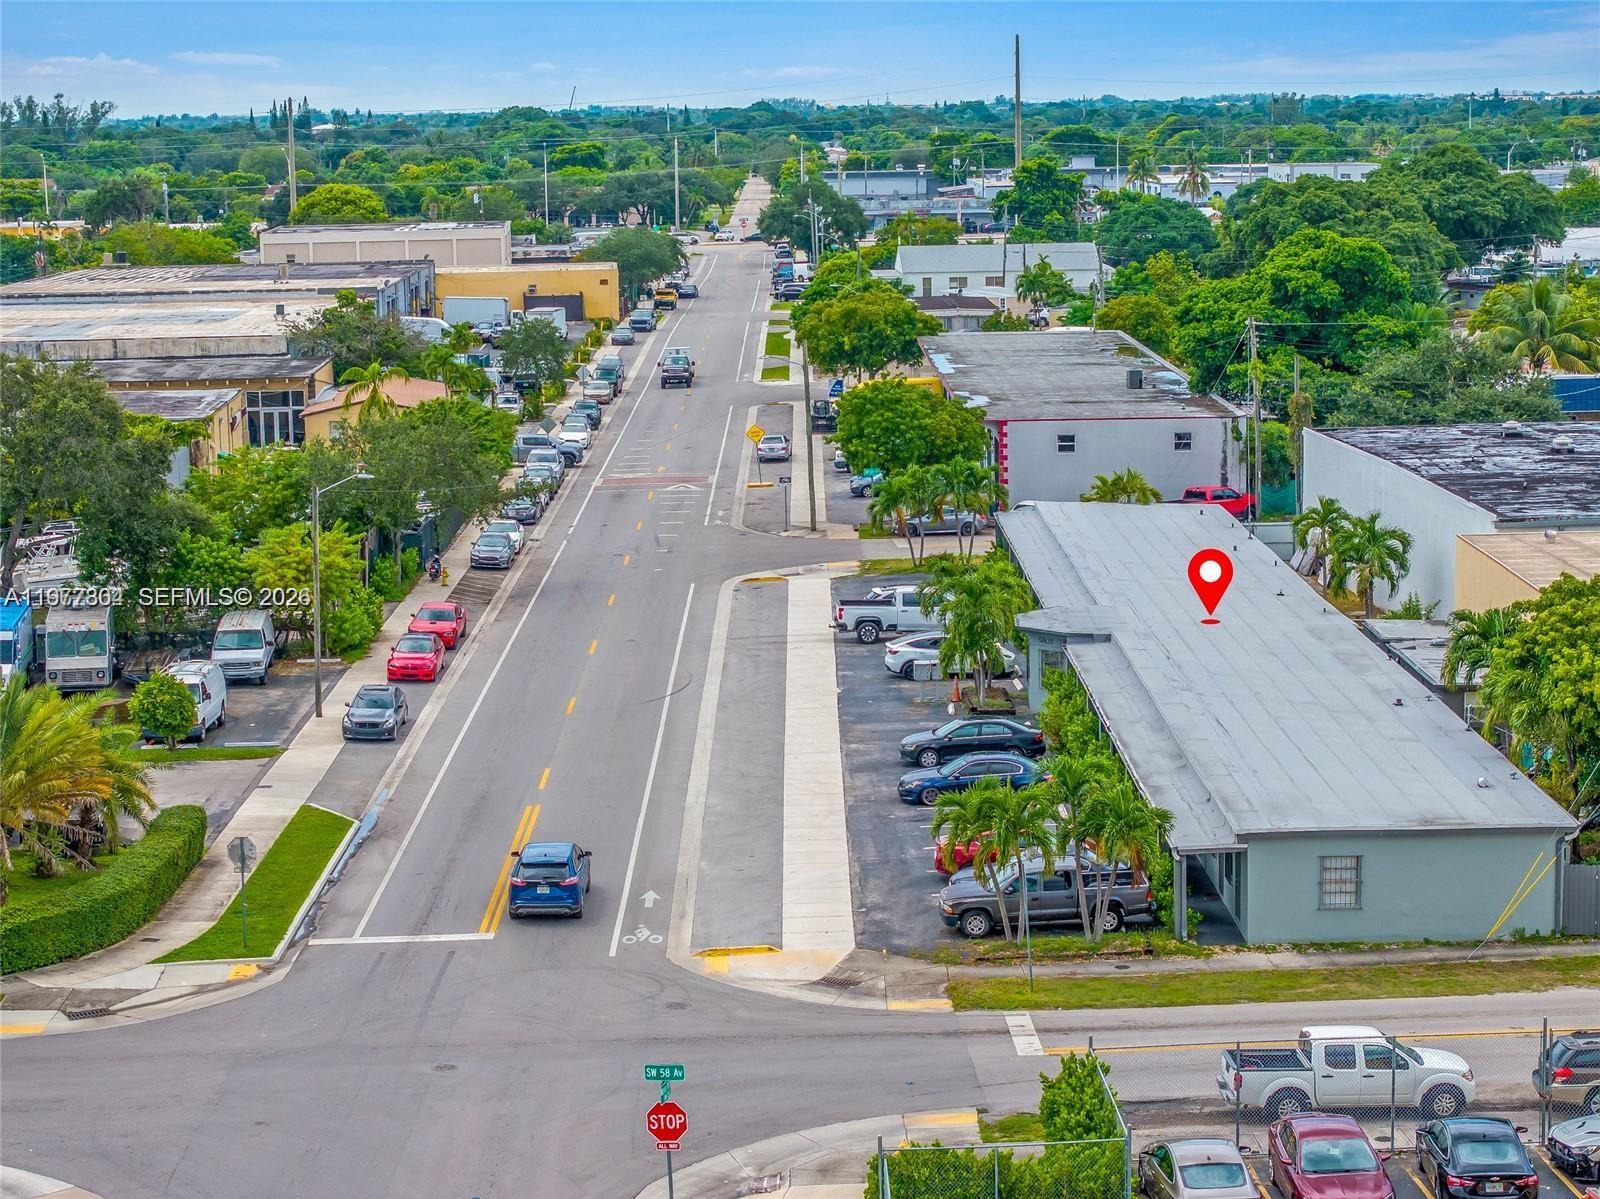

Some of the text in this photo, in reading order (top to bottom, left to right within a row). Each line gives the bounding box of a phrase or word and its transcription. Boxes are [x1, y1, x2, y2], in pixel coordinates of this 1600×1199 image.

[646, 1067, 683, 1078] SW 58 Av
[649, 1114, 685, 1130] STOP
